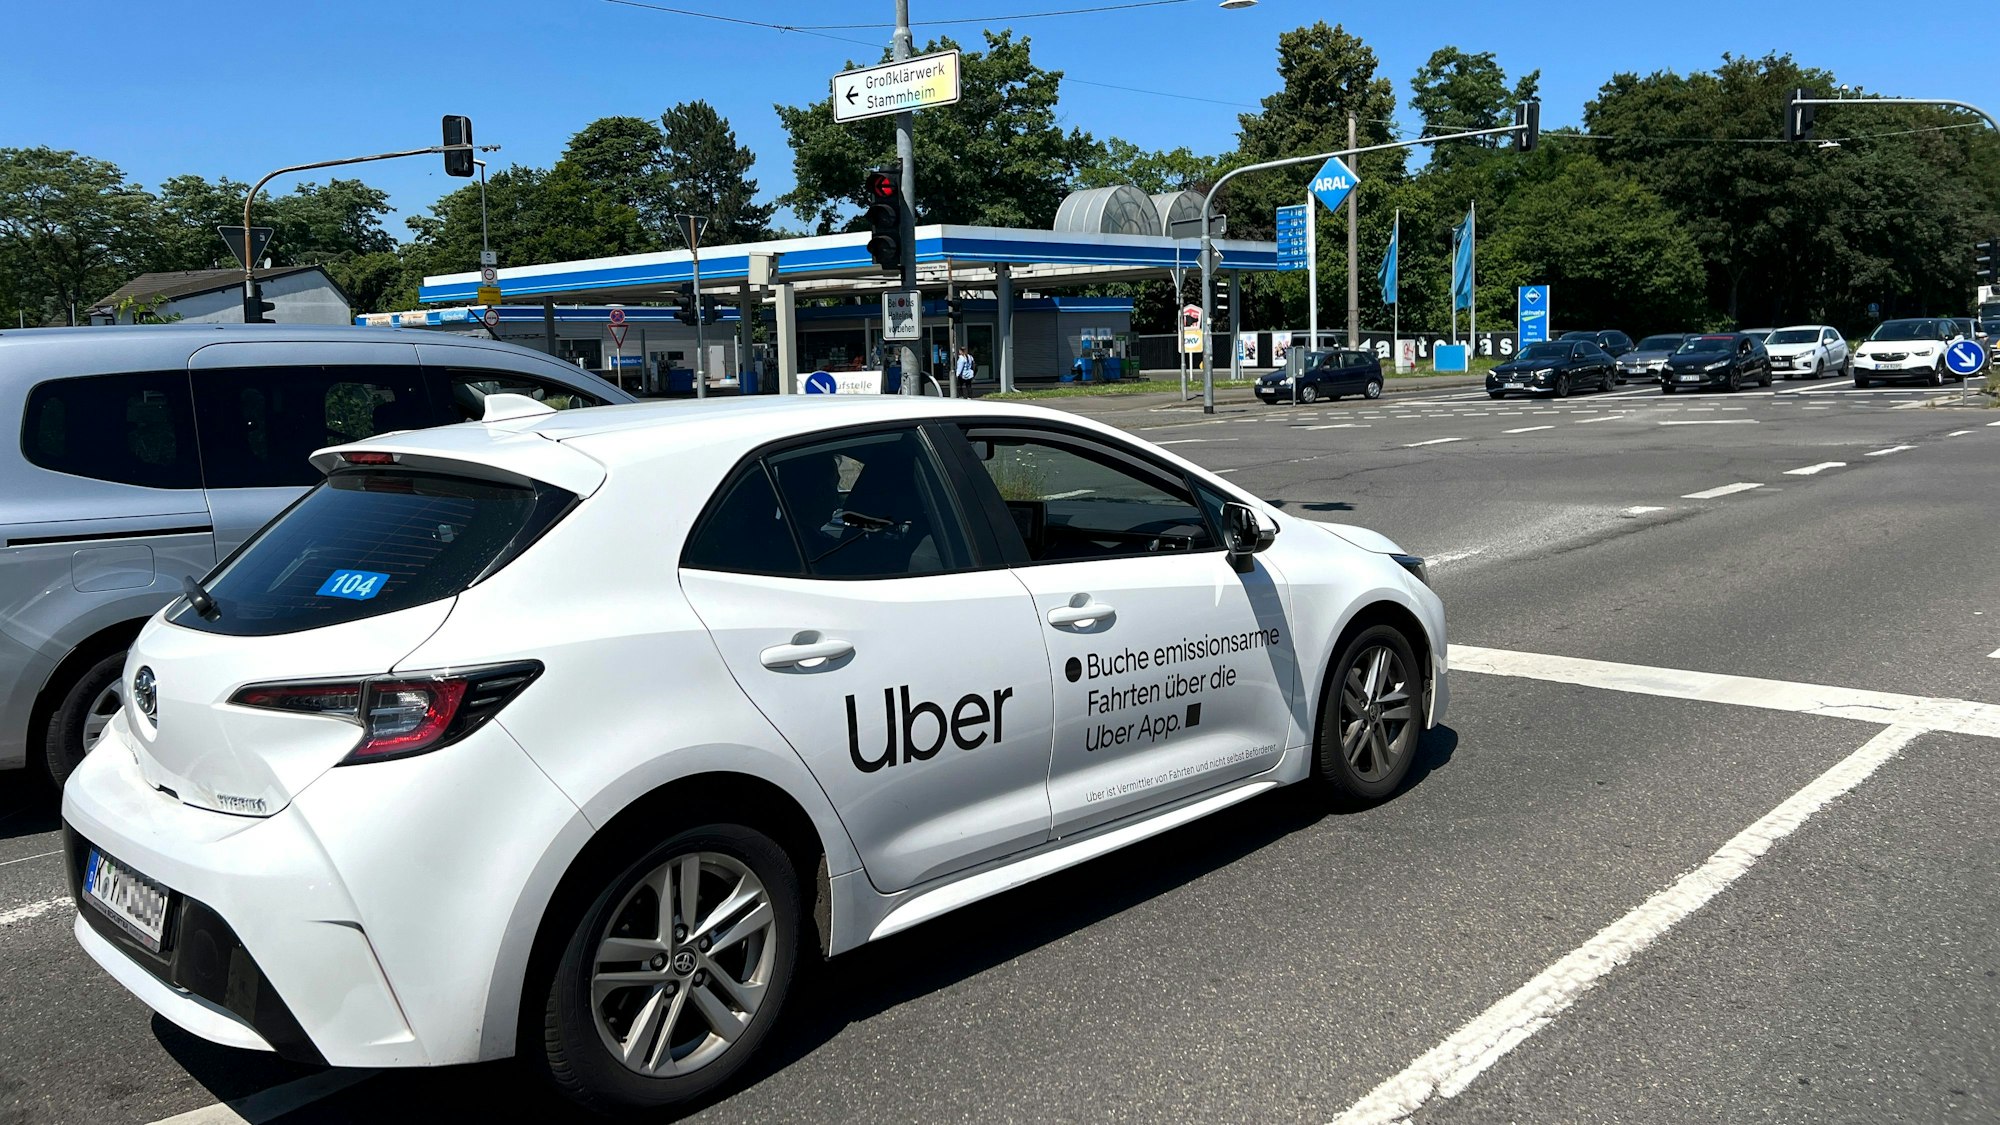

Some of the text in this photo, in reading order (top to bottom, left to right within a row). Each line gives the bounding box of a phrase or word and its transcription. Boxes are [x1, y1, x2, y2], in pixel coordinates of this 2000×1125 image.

[865, 62, 945, 89] Großklärwerk
[867, 86, 935, 109] Stammheim
[1314, 176, 1349, 192] ARAL
[888, 297, 915, 308] Bei bis
[331, 573, 378, 596] 104
[1087, 627, 1280, 680] Buche emissionsarme
[1088, 664, 1236, 717] Fahrten über die
[845, 684, 1013, 773] Uber
[1085, 713, 1181, 752] Uber App.
[1086, 743, 1277, 803] Uber ist Vermittler von Fahrten und nicht selbst Beförderer
